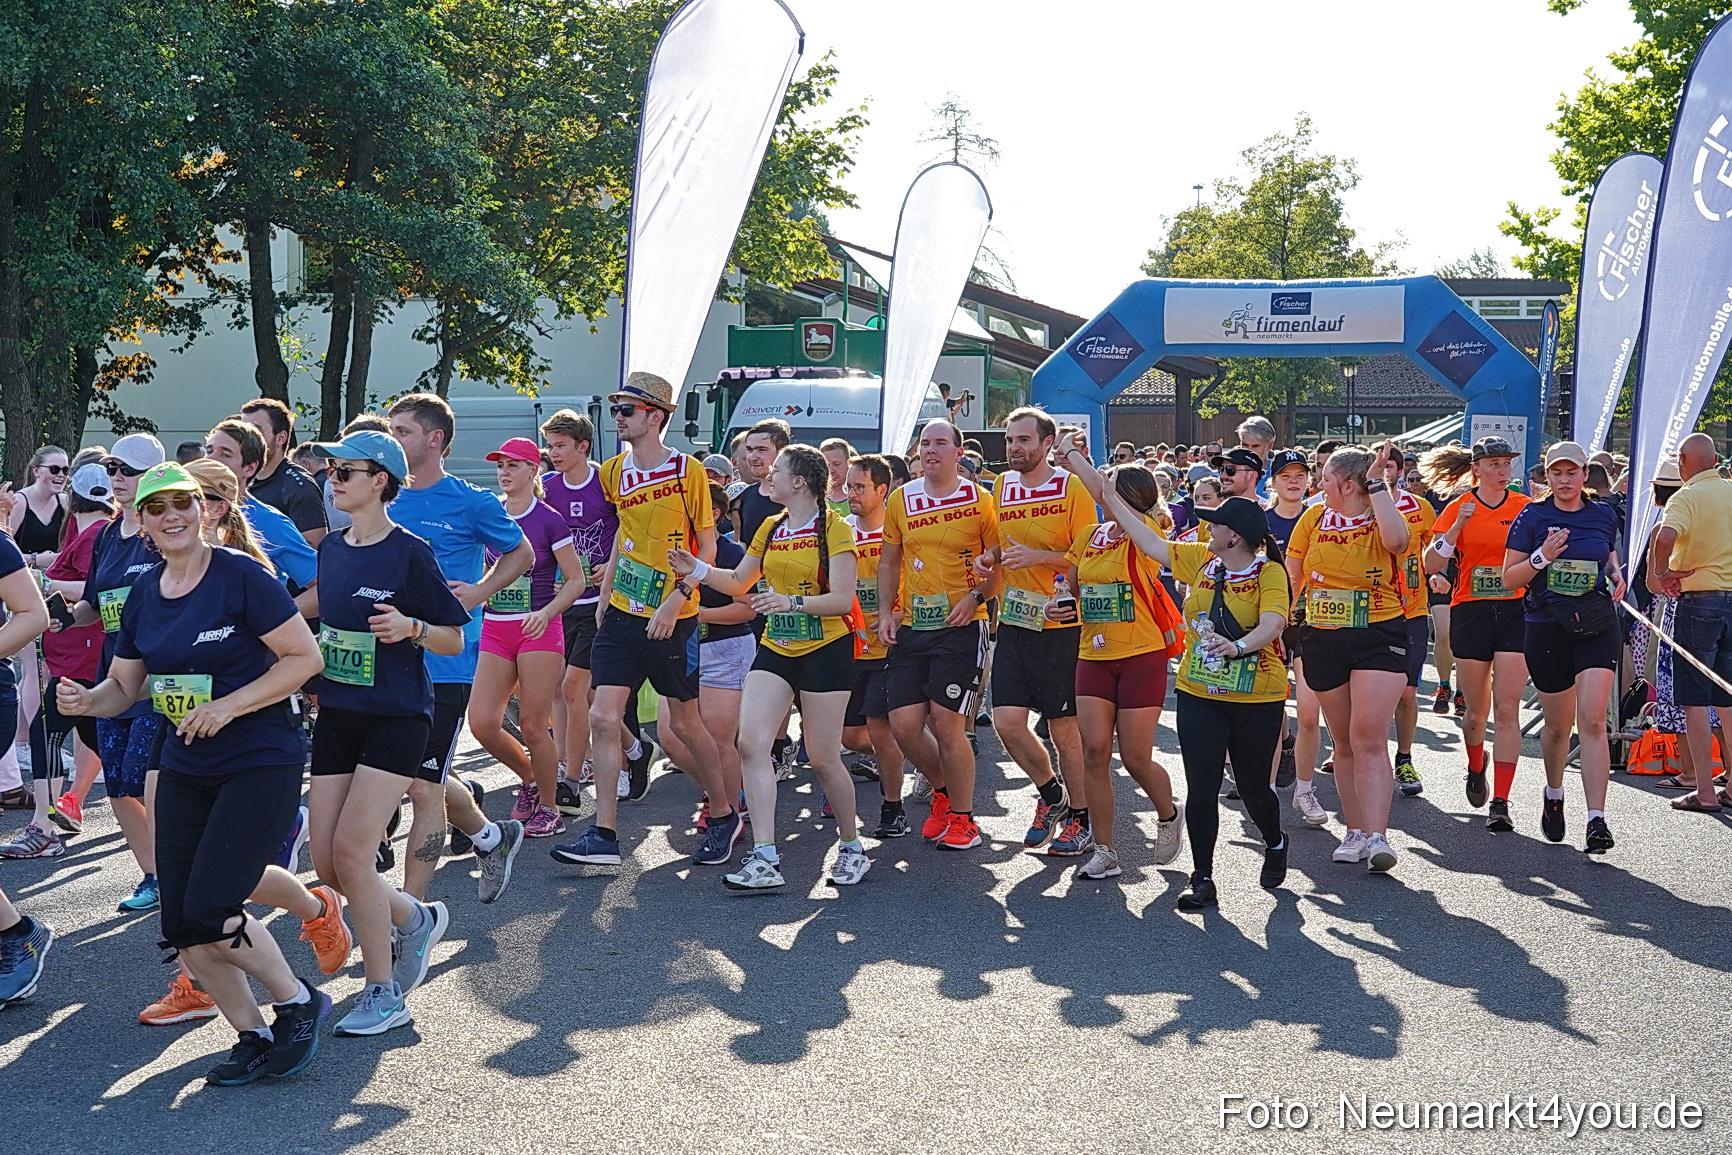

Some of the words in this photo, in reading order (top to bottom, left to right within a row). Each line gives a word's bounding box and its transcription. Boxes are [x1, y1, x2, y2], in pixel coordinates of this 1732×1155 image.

[1610, 180, 1653, 282] Fischer
[1256, 314, 1346, 332] firmenlauf
[1085, 344, 1133, 355] Fischer
[741, 405, 782, 415] abavent
[815, 409, 875, 417] DATASPORT
[653, 483, 688, 500] BÖGL
[907, 515, 940, 531] MAX
[943, 506, 981, 522] BÖGL
[999, 509, 1028, 522] MAX
[1031, 503, 1066, 518] BÖGL
[1317, 534, 1349, 545] MAX
[620, 570, 639, 588] 801
[1555, 571, 1590, 584] 1273
[495, 589, 523, 601] 1556
[641, 581, 649, 599] 2022
[1008, 599, 1038, 618] 1630
[1084, 597, 1112, 610] 1602
[1315, 601, 1346, 615] 1599
[774, 614, 795, 628] 810
[915, 606, 943, 619] 1622
[324, 644, 363, 668] 1170
[340, 666, 360, 676] Agnes
[363, 653, 372, 679] 2022
[1189, 656, 1198, 676] WALK
[1229, 665, 1239, 685] 2022
[165, 695, 196, 714] 874
